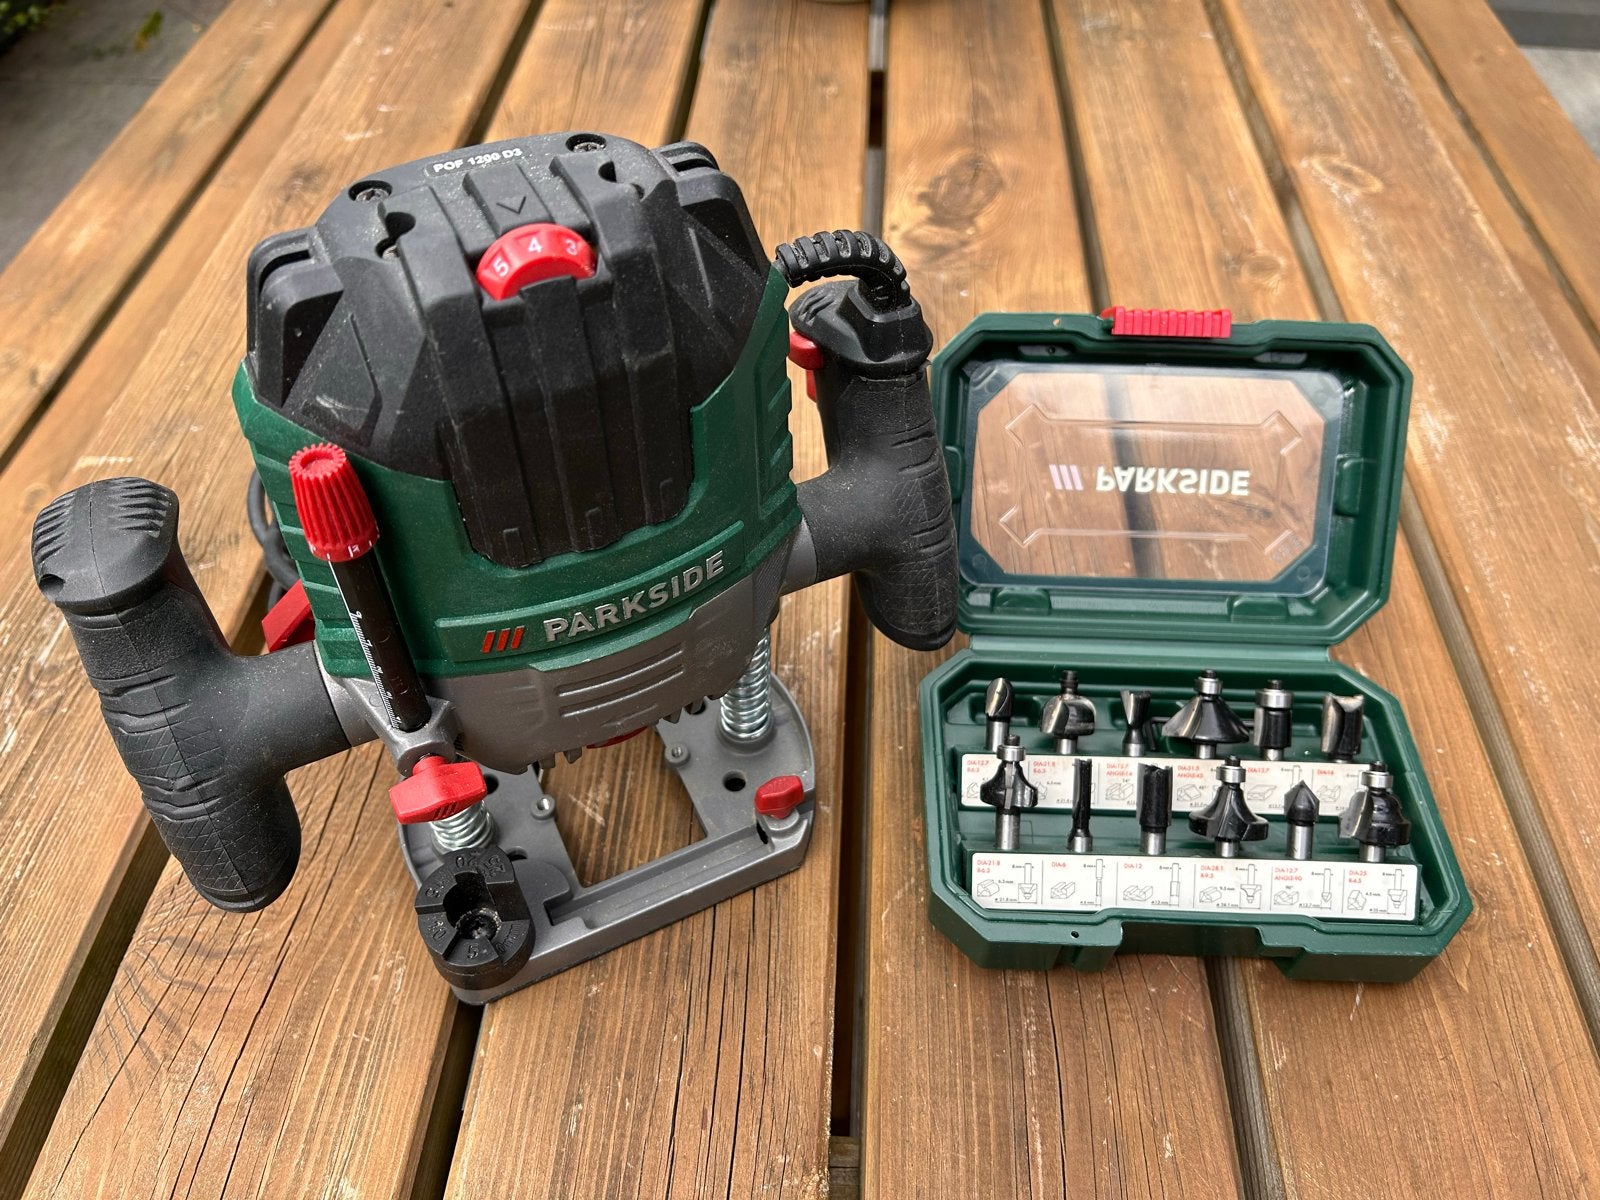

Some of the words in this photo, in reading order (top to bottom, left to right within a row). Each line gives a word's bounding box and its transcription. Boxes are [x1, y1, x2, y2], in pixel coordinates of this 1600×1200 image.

[433, 159, 463, 173] POF
[468, 152, 500, 166] 1200
[502, 148, 523, 159] D3
[493, 259, 509, 277] 5
[528, 237, 542, 253] 4
[565, 239, 578, 256] 3
[543, 550, 724, 642] PARKSIDE
[466, 943, 479, 959] 5
